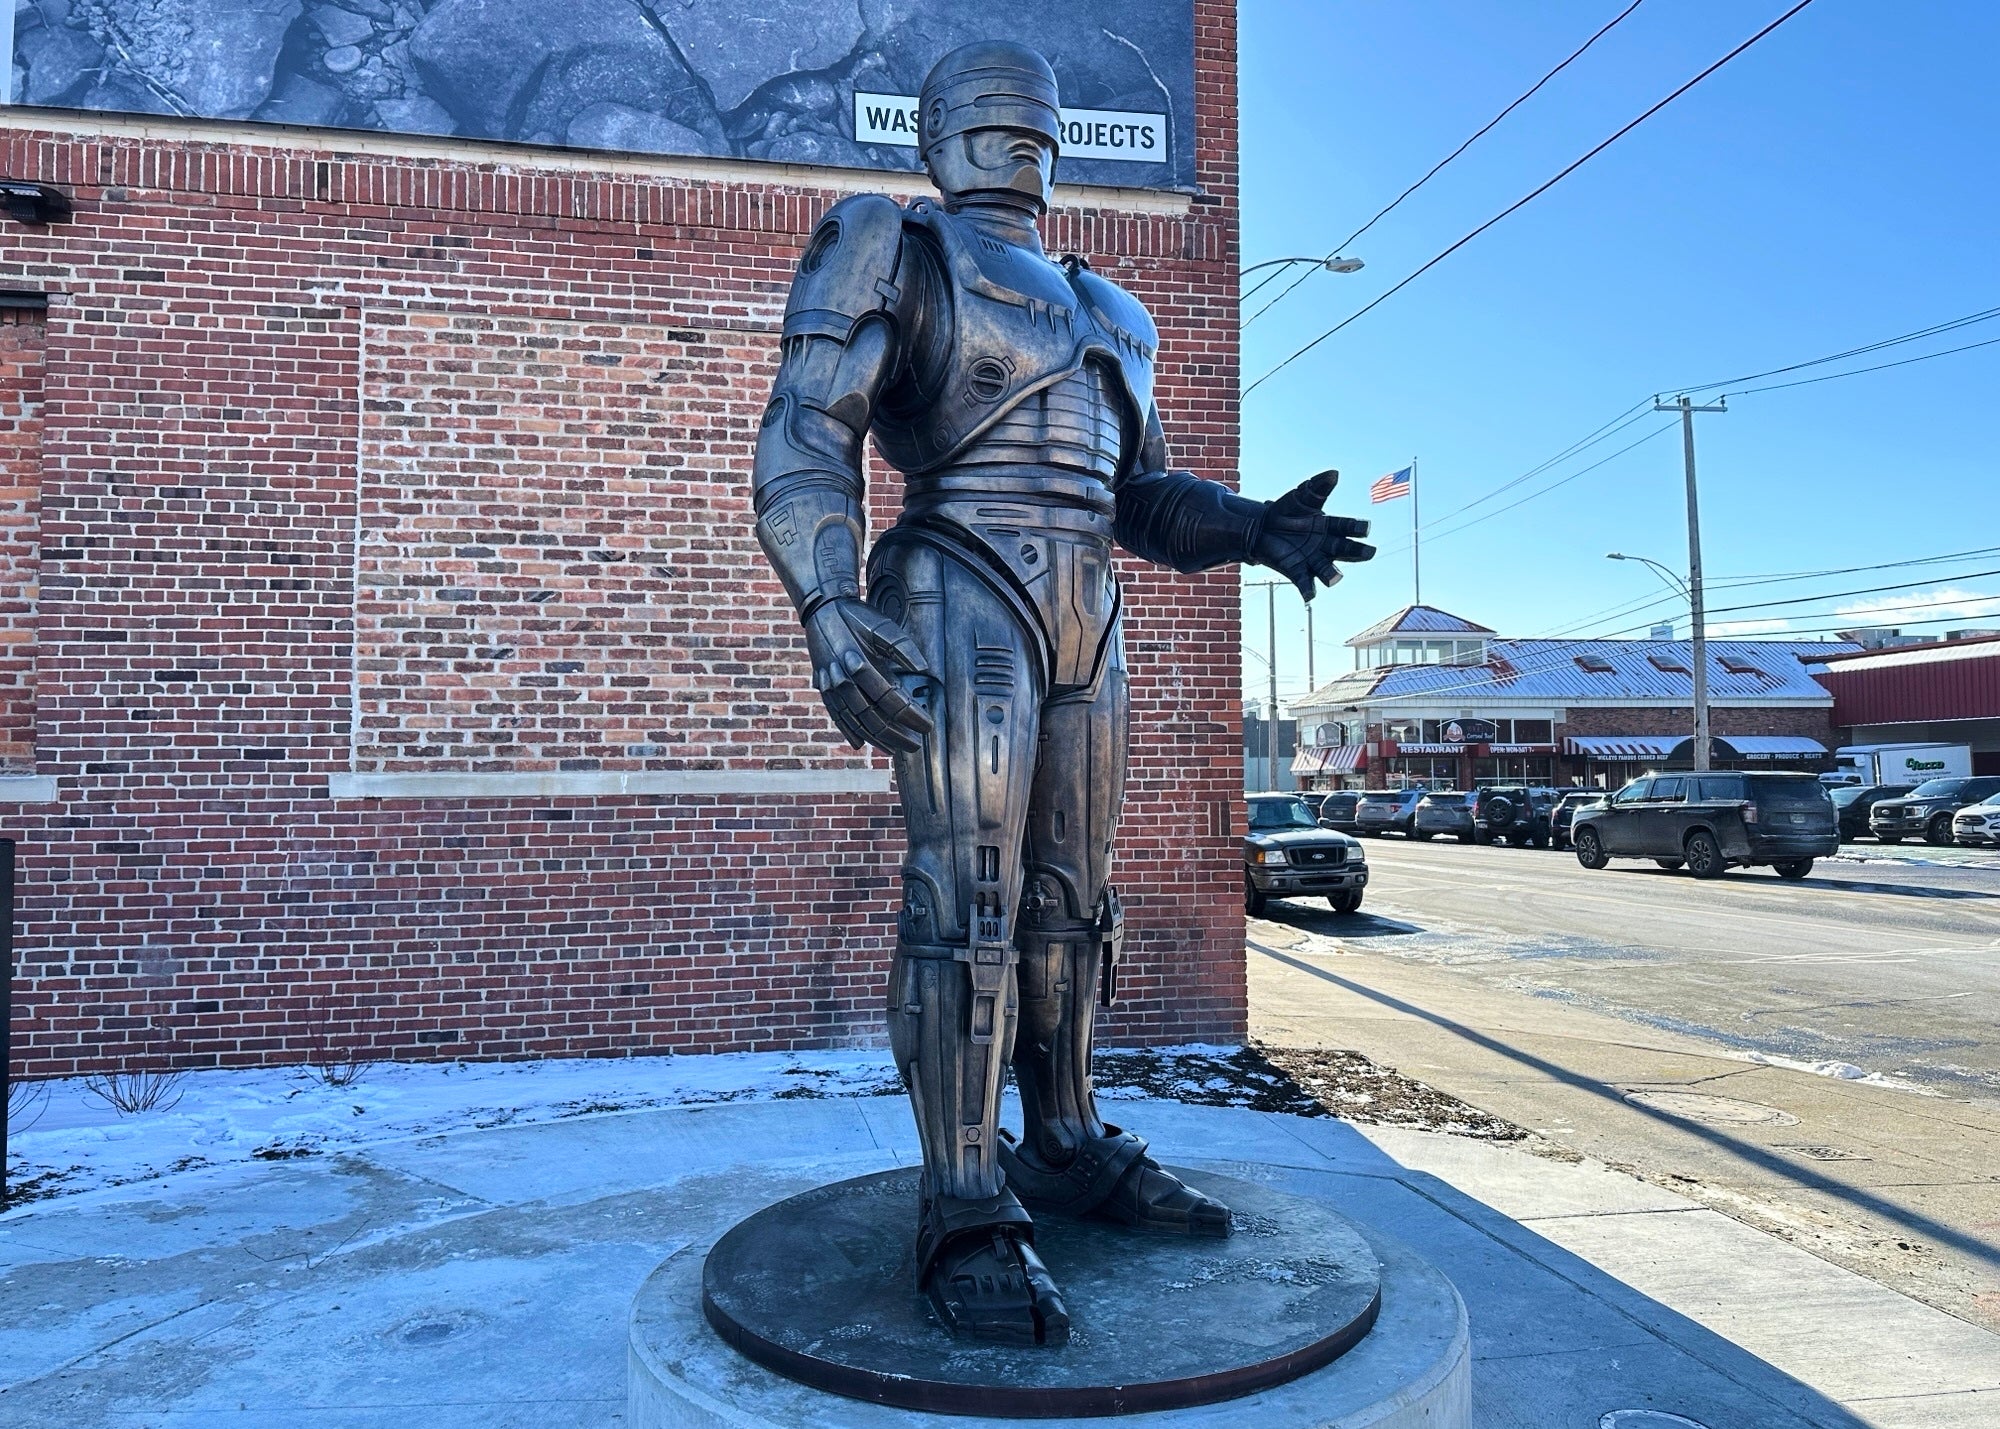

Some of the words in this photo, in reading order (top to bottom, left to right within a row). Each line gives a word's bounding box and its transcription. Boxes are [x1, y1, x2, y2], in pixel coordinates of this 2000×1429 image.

[866, 106, 920, 133] WAS
[1058, 121, 1155, 149] ROJECTS
[1400, 746, 1465, 754] RESTAURANT
